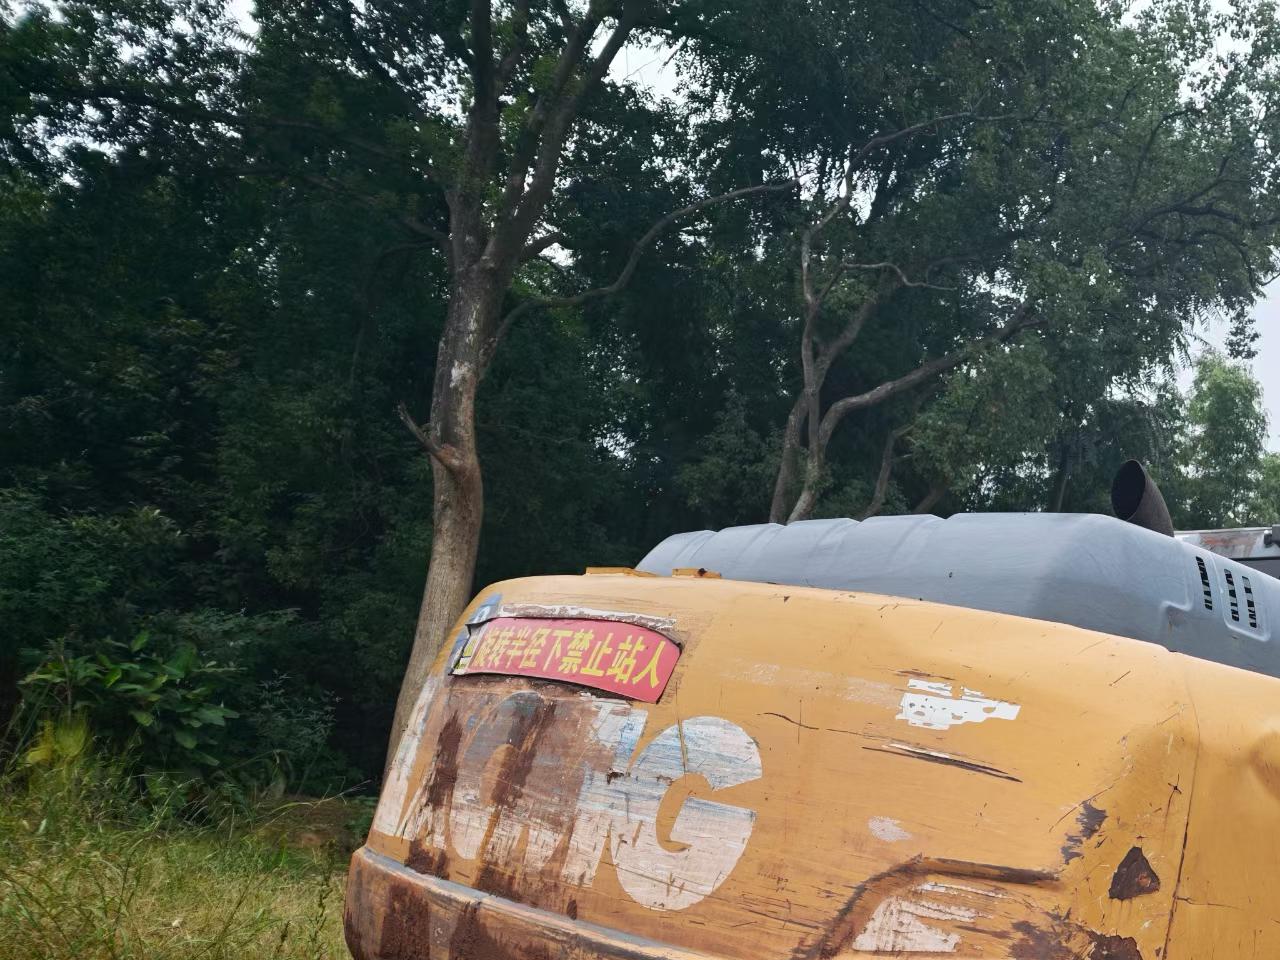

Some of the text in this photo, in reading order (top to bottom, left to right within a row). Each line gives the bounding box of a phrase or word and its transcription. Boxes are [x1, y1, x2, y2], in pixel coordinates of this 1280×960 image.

[470, 624, 667, 689] 旋转半径下禁止站人
